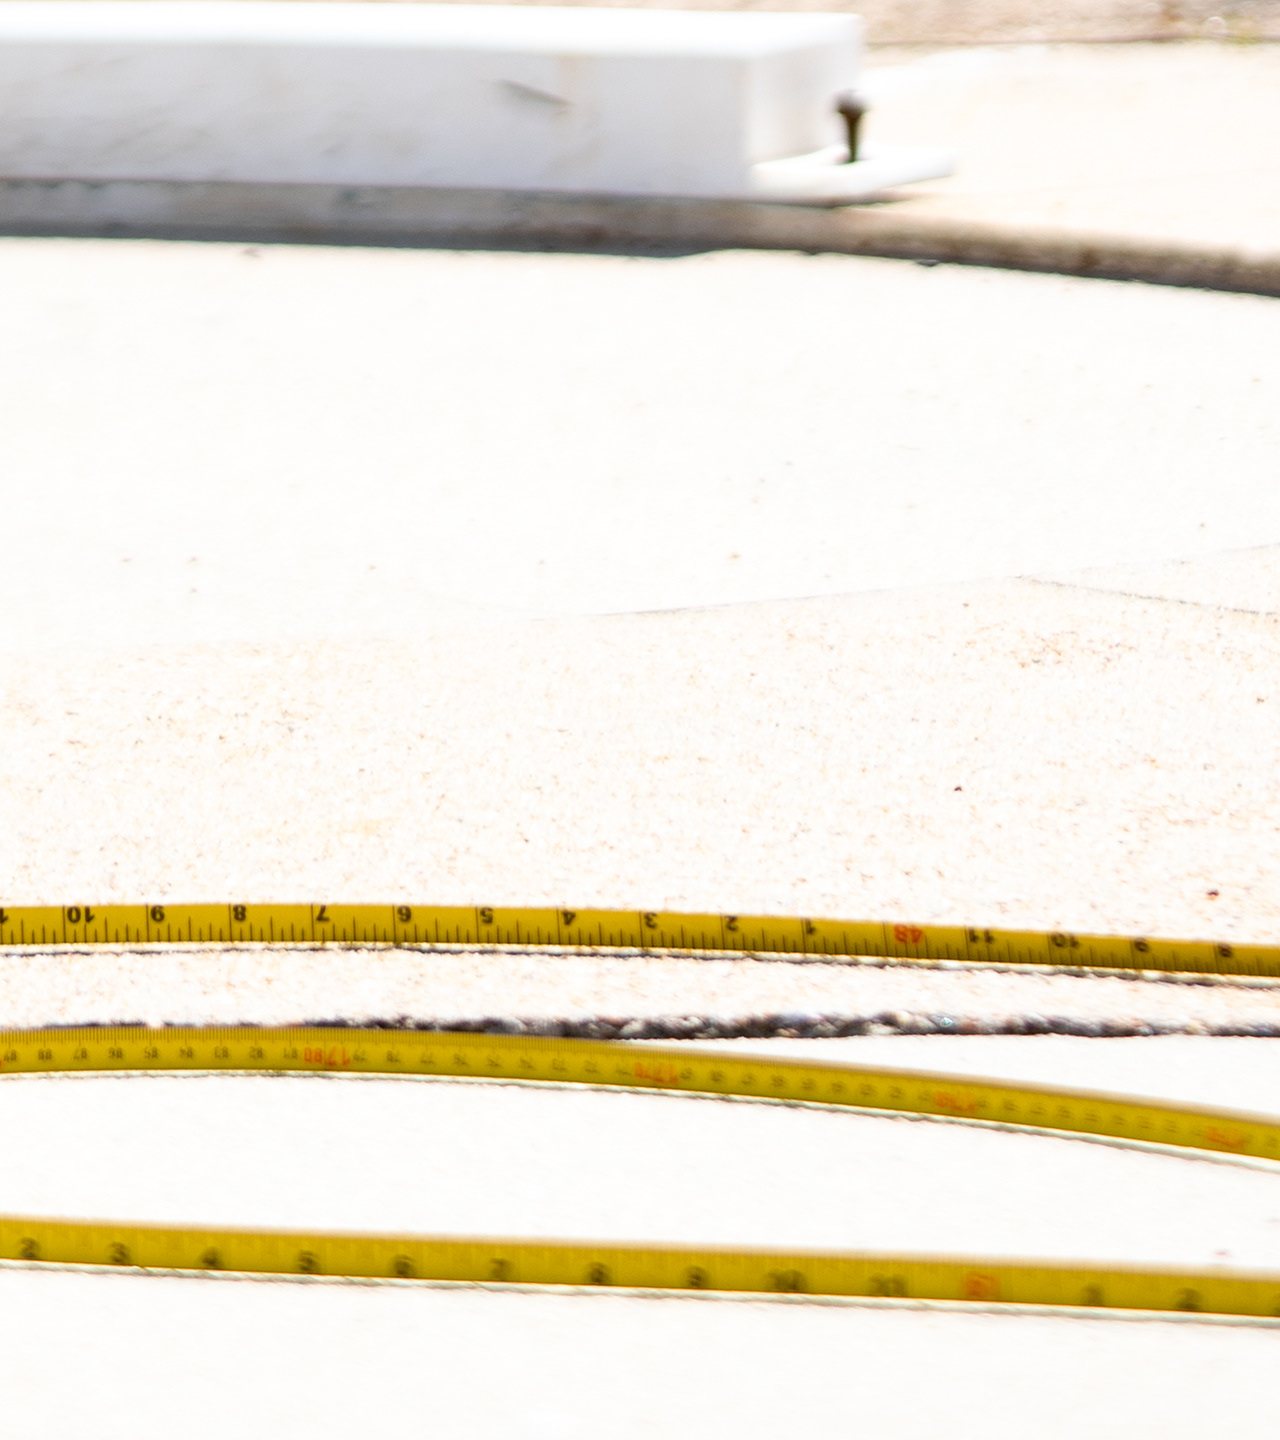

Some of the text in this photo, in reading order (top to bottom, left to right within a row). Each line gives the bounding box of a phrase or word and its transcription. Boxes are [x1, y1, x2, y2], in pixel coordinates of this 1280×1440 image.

[67, 905, 95, 923] 10
[150, 905, 165, 922] 9
[232, 905, 247, 922] 8
[316, 906, 331, 922] 7
[397, 905, 412, 922] 6
[480, 908, 494, 923] 5
[562, 911, 576, 926] 4
[644, 912, 658, 929] 3
[725, 915, 739, 931] 2
[804, 919, 817, 935] 1
[893, 925, 923, 943] 48
[969, 928, 996, 944] 11
[1051, 932, 1079, 948] 10
